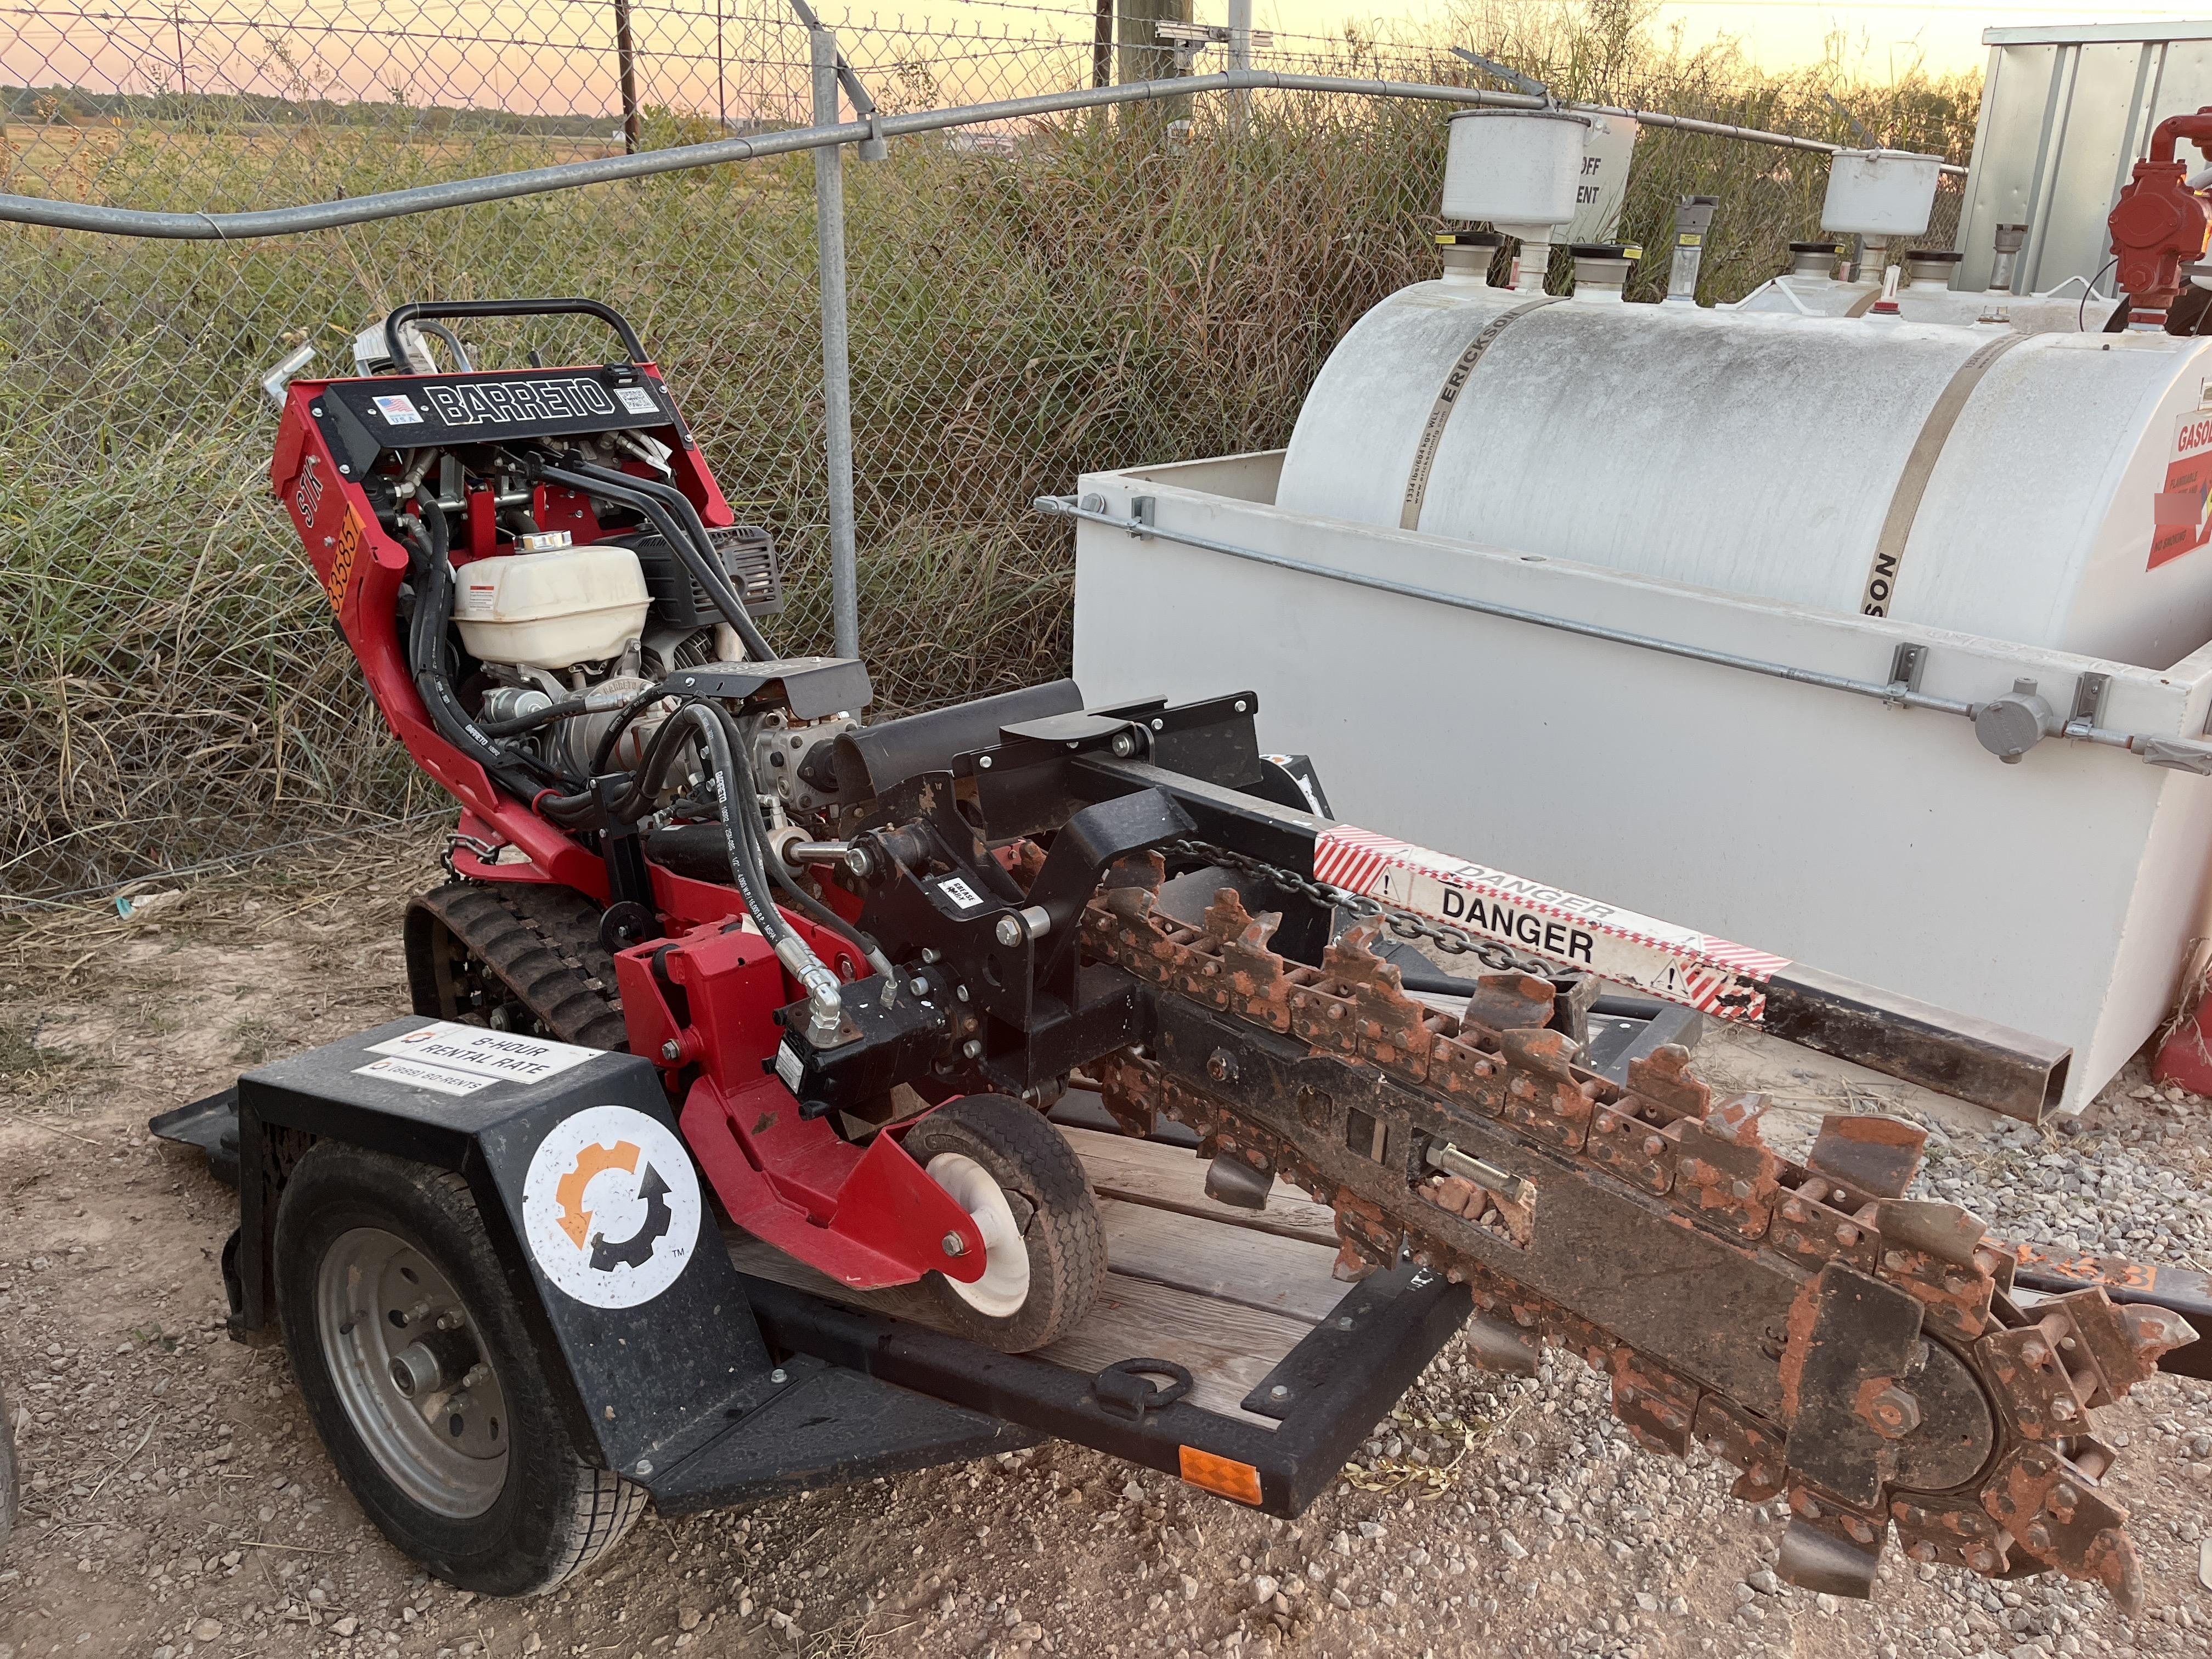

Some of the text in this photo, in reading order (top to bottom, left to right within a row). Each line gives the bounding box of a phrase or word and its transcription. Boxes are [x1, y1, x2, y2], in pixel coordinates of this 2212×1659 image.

[1441, 311, 1520, 403] ERICKSON
[422, 379, 616, 426] BARRETO
[1406, 410, 1440, 503] 1334 lbs/604 kgs WLL
[296, 455, 323, 528] STK
[327, 503, 359, 614] 335857
[465, 724, 488, 746] BARRETO
[715, 770, 727, 804] BARRETO
[721, 806, 729, 823] 100R2
[764, 924, 776, 940] MSHA
[953, 883, 975, 901] GREASE
[1454, 865, 1616, 921] DANGER
[1442, 887, 1593, 964] DANGER
[420, 1044, 551, 1075] RENTAL RATE
[471, 1037, 550, 1057] 8-HOUR
[672, 1248, 685, 1259] TM
